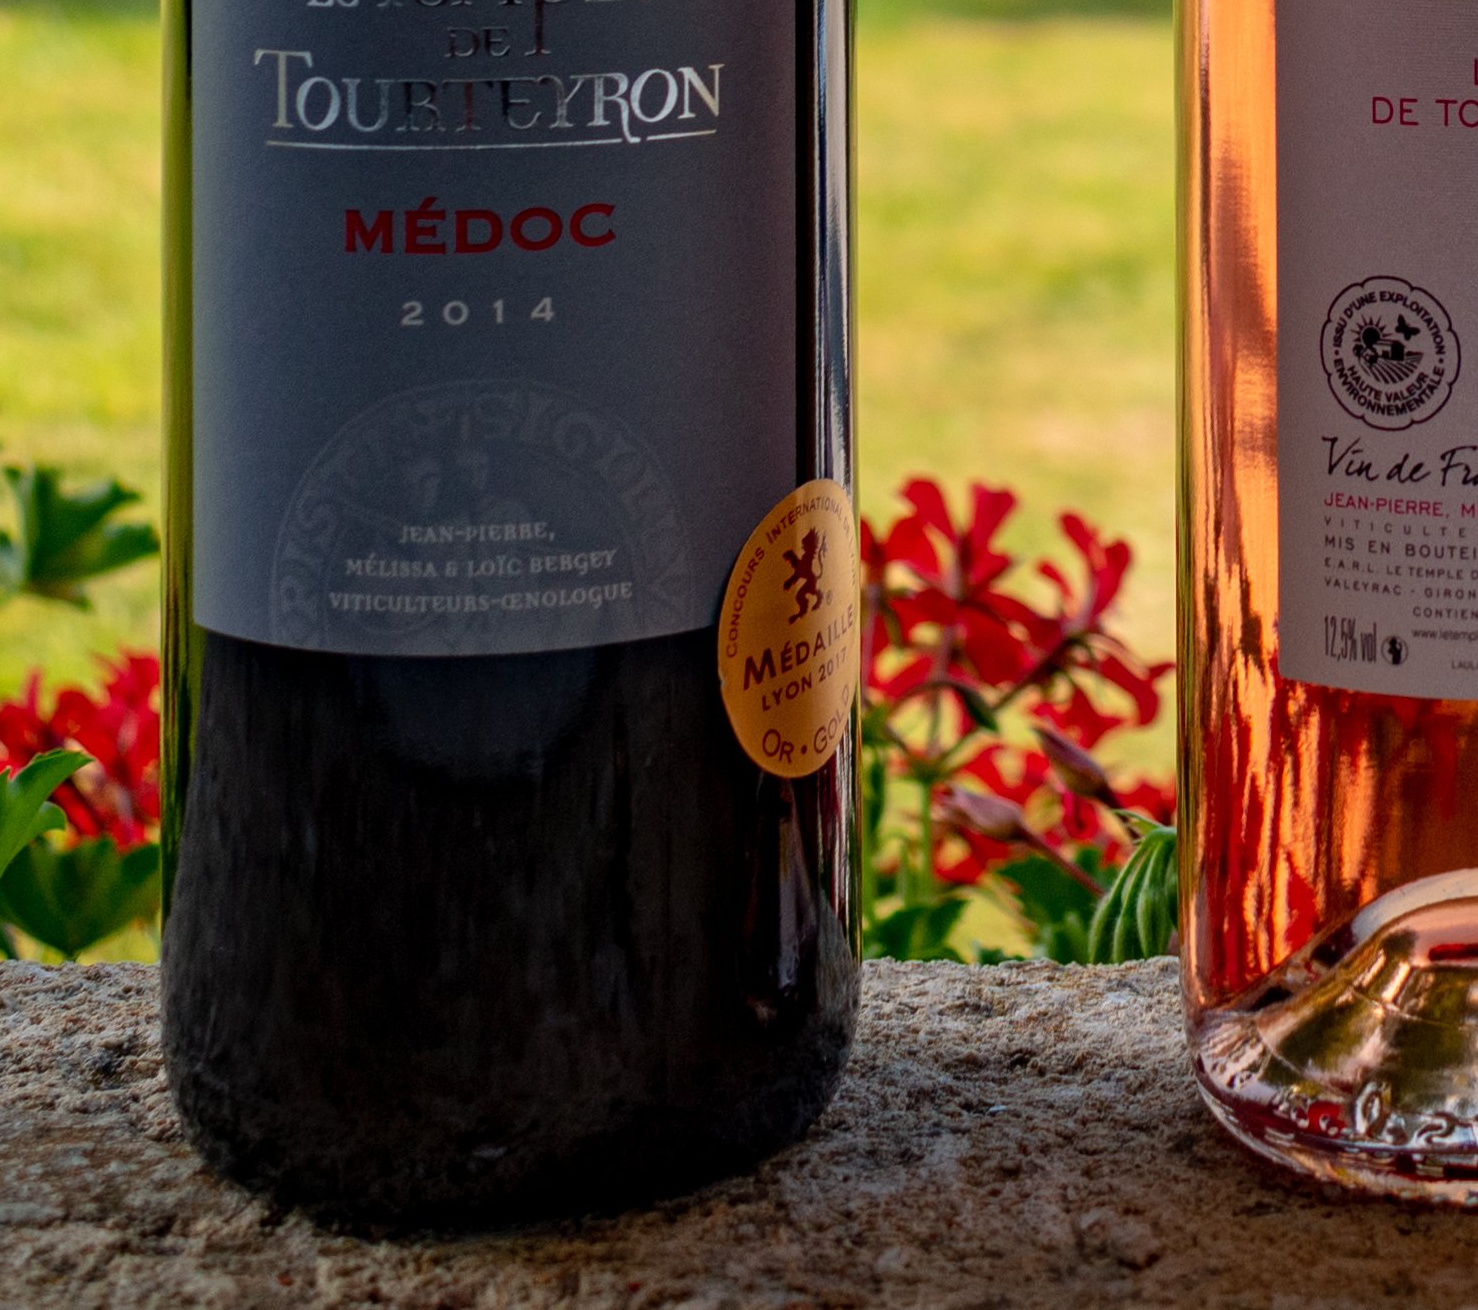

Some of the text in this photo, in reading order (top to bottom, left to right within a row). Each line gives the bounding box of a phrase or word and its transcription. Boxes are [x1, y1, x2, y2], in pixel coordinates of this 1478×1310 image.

[443, 26, 512, 59] DE
[253, 48, 725, 144] TOURTEYRON
[1371, 96, 1420, 127] DE
[344, 197, 617, 255] MÉDOC
[400, 296, 556, 327] 2014
[1333, 290, 1446, 356] ISSU D'UNE EXPLOITATION
[1333, 357, 1446, 417] ENVIRONNEMENTALE
[1346, 365, 1430, 403] HAUTE VALEUR
[1320, 436, 1380, 483] Vin
[1385, 452, 1432, 484] de
[1323, 491, 1451, 520] JEAN-PIERRE,
[398, 522, 556, 545] JEAN-PIERRE,
[1324, 533, 1356, 552] MIS
[1366, 539, 1392, 555] EN
[345, 553, 437, 579] MÉLISSA
[467, 556, 524, 577] LOÏC
[529, 548, 619, 576] BERGEY
[725, 547, 766, 660] CONCOURS
[765, 495, 844, 546] INTERNATIONAL
[1385, 563, 1404, 578] LE
[1408, 565, 1465, 581] TEMPLE
[1323, 574, 1404, 597] VALEYRAC
[743, 602, 855, 692] MÉDAILLE
[1323, 614, 1378, 664] 12,5% vol
[761, 646, 848, 713] LYON 2017
